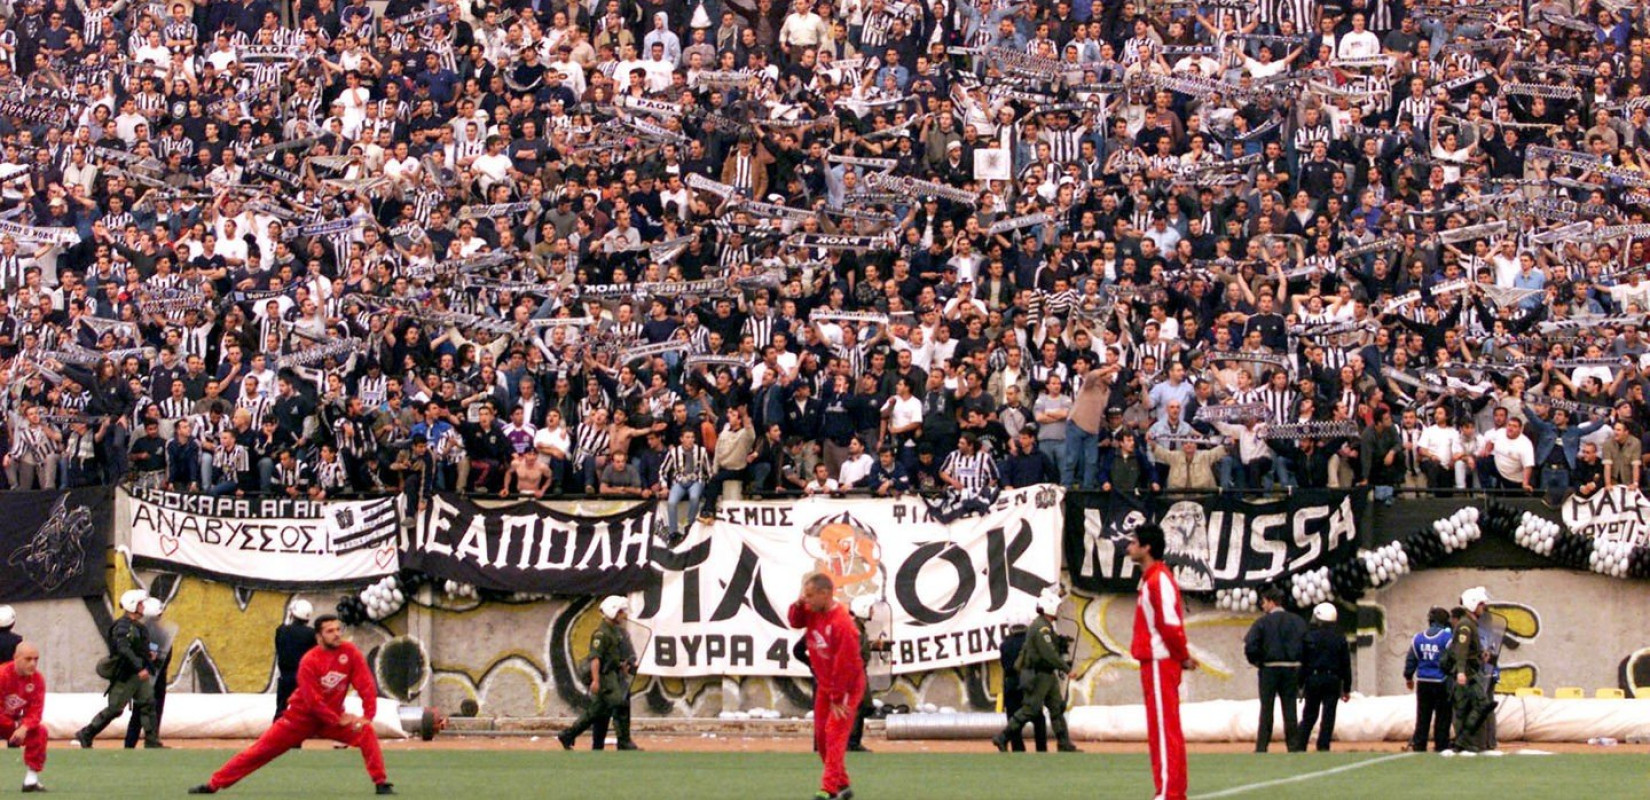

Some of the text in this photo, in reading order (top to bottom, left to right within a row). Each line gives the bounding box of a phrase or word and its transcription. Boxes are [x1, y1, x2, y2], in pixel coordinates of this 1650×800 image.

[248, 46, 289, 54] ΠΑΟΚ
[637, 99, 675, 111] PAOK
[767, 637, 790, 669] 4
